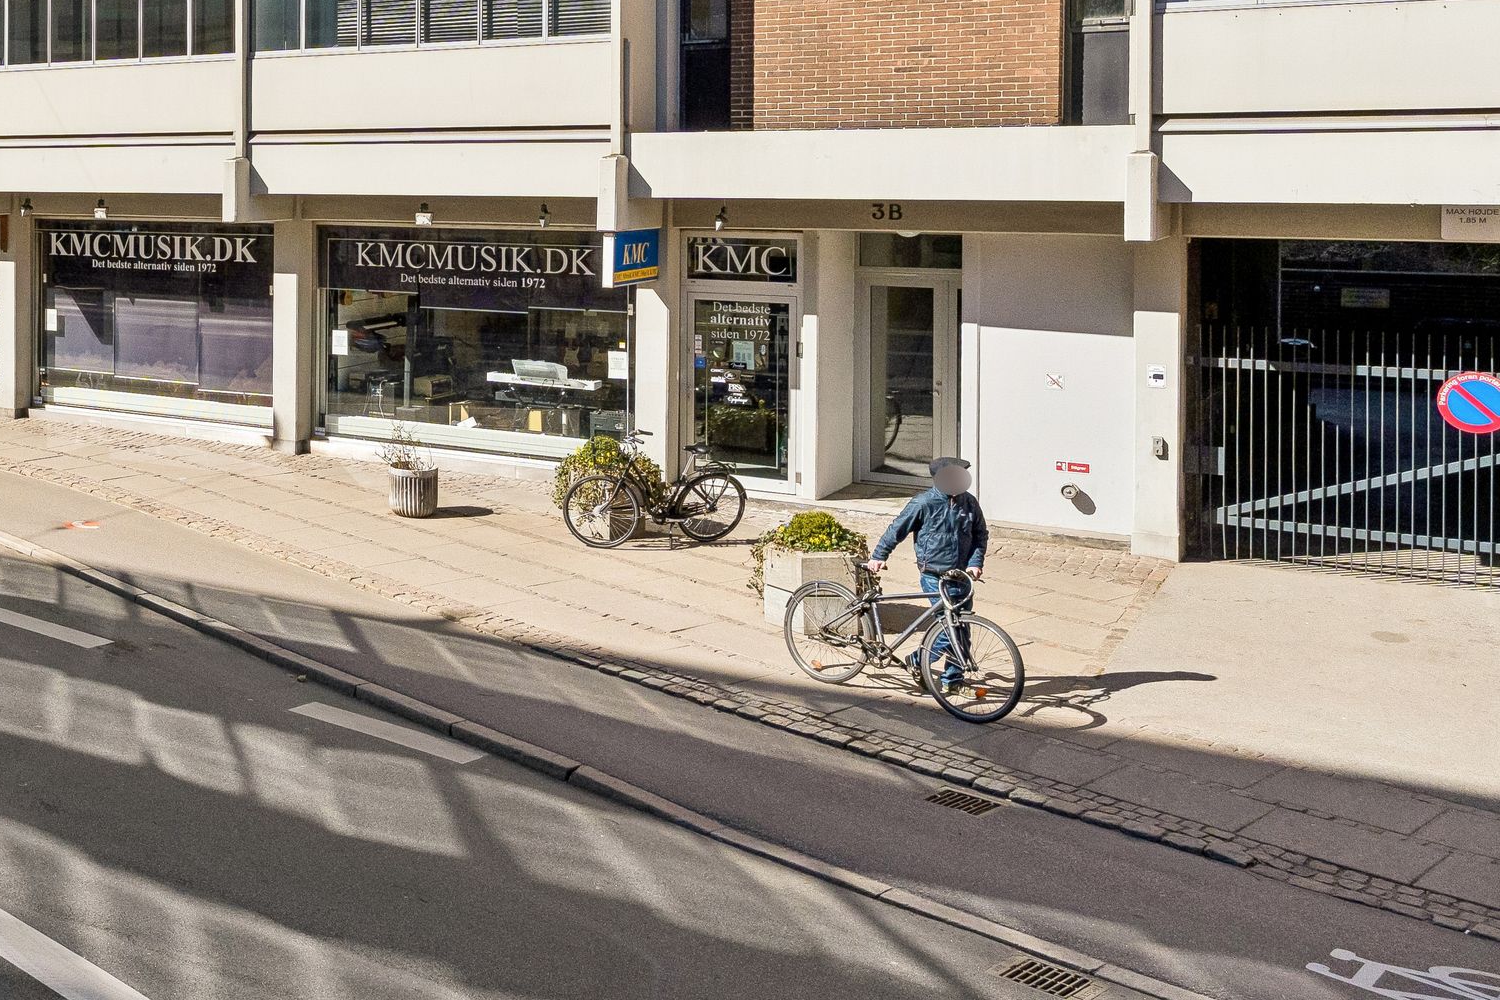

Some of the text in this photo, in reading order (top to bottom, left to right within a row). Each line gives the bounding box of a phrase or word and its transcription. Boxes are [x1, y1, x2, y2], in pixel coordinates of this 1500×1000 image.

[871, 203, 903, 220] 3B
[1468, 208, 1499, 216] HØJDE
[49, 232, 258, 263] KMCMUSIK.DK
[623, 242, 650, 265] KMC
[92, 258, 217, 272] Det bedste alternativ siden 1972
[355, 242, 596, 276] KMCMUSIK.DK
[694, 244, 787, 276] KMC
[400, 274, 546, 288] Det bedste alternativ siden 1972
[713, 302, 771, 314] Det bedste
[710, 314, 772, 326] alternativ
[711, 328, 771, 341] siden 1972
